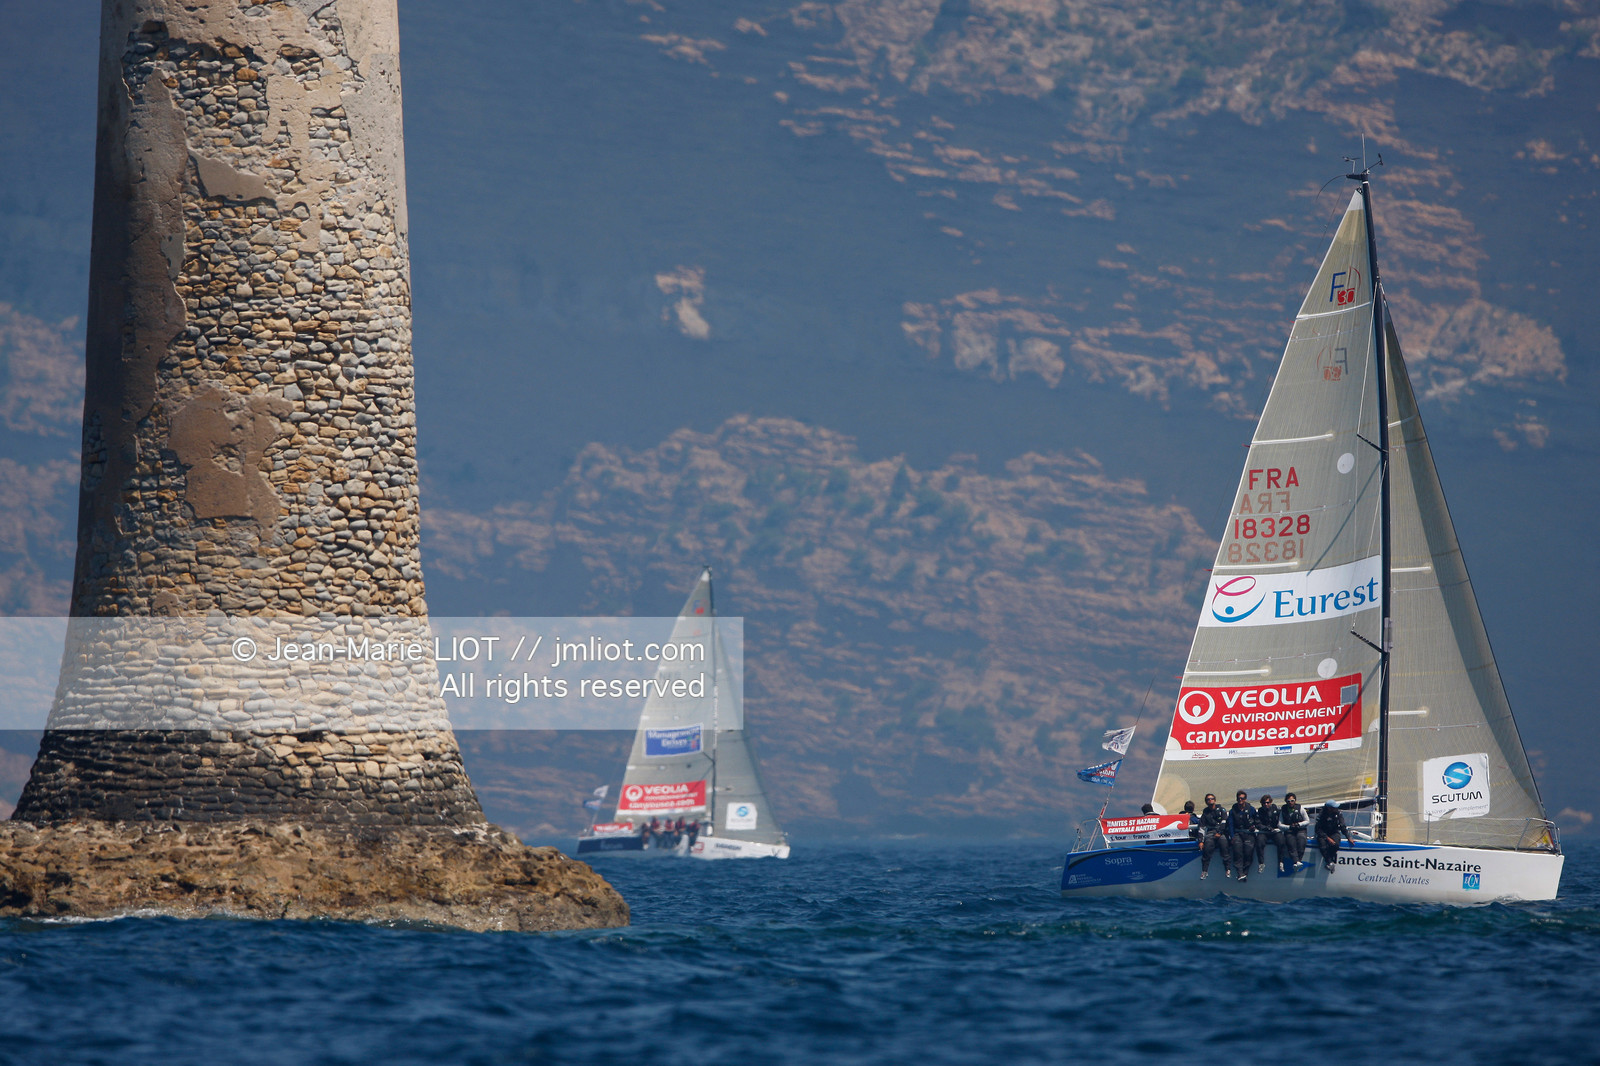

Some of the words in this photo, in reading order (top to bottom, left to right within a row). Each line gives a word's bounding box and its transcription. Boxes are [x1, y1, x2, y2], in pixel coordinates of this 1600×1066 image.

[1248, 466, 1300, 490] FRA
[1234, 514, 1311, 540] 18328
[1272, 576, 1379, 619] Eurest
[1220, 685, 1323, 709] VEOLIA
[1221, 704, 1345, 724] ENVIRONNEMENT
[1185, 721, 1336, 748] canyousea.com
[643, 784, 689, 795] VEOLIA
[1431, 790, 1483, 804] SCUTUM
[1106, 819, 1128, 828] NANTES
[1136, 817, 1160, 825] NAZAIRE
[1107, 825, 1135, 834] CENTRALE
[1135, 824, 1157, 832] NANTES
[1104, 856, 1132, 866] Sopra
[1382, 855, 1482, 873] Saint-Nazaire
[1357, 872, 1396, 884] Centrale
[1399, 875, 1430, 885] Nantes
